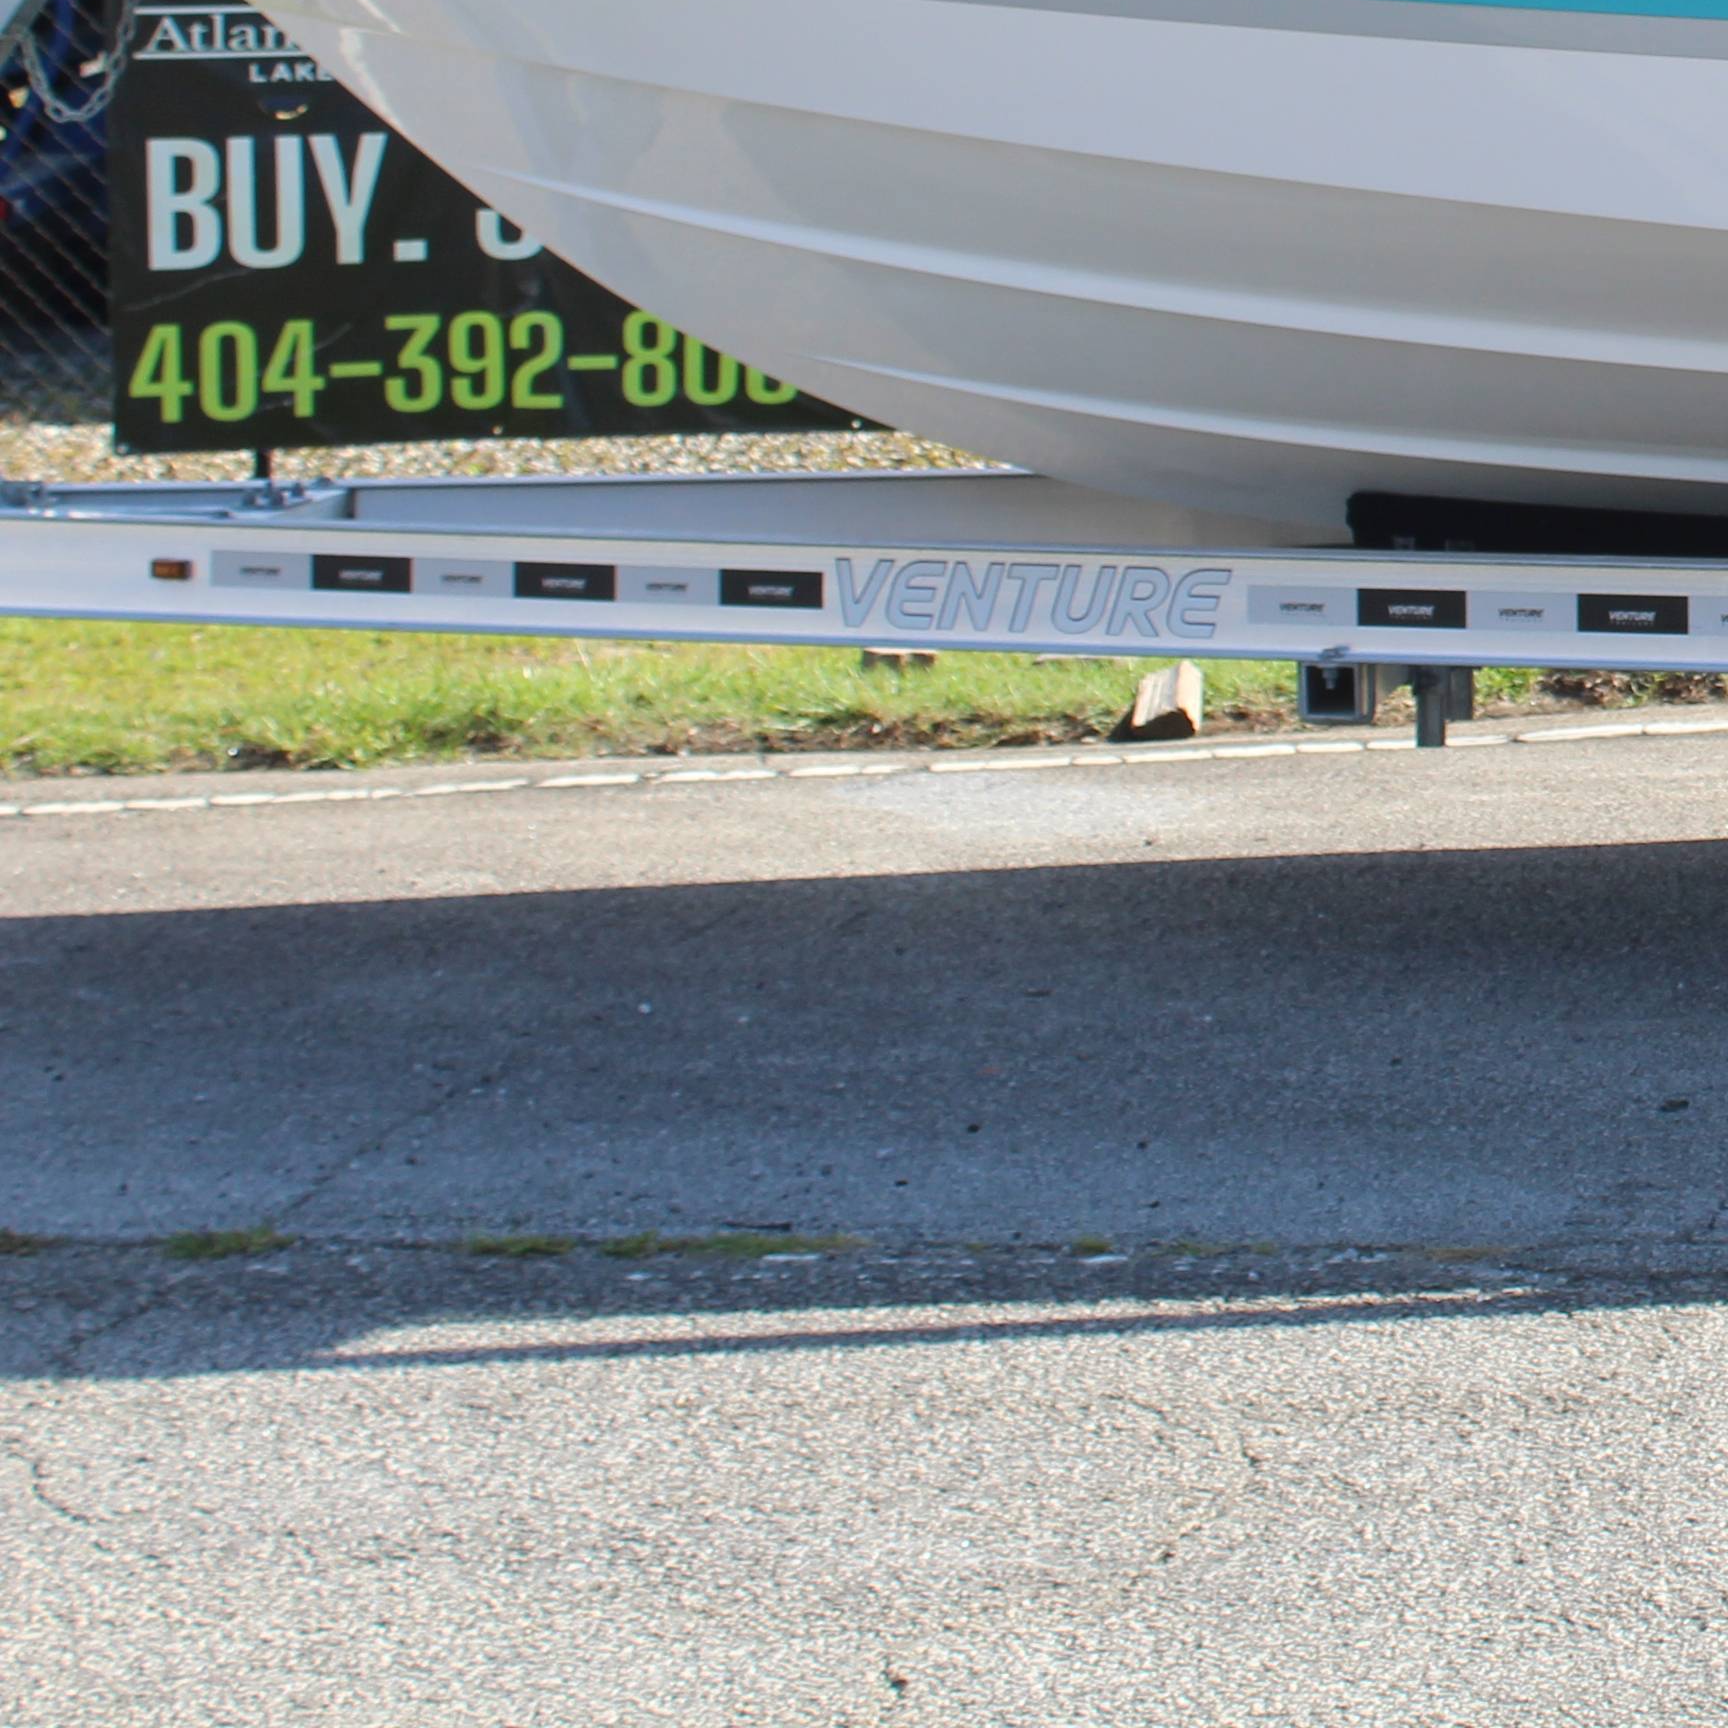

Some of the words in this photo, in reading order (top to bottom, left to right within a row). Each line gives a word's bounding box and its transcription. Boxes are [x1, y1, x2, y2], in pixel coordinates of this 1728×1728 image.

[145, 131, 428, 270] BUY.
[834, 557, 1233, 640] VENTURE
[1387, 604, 1436, 617] VENTURE
[1608, 610, 1657, 622] VENTURE
